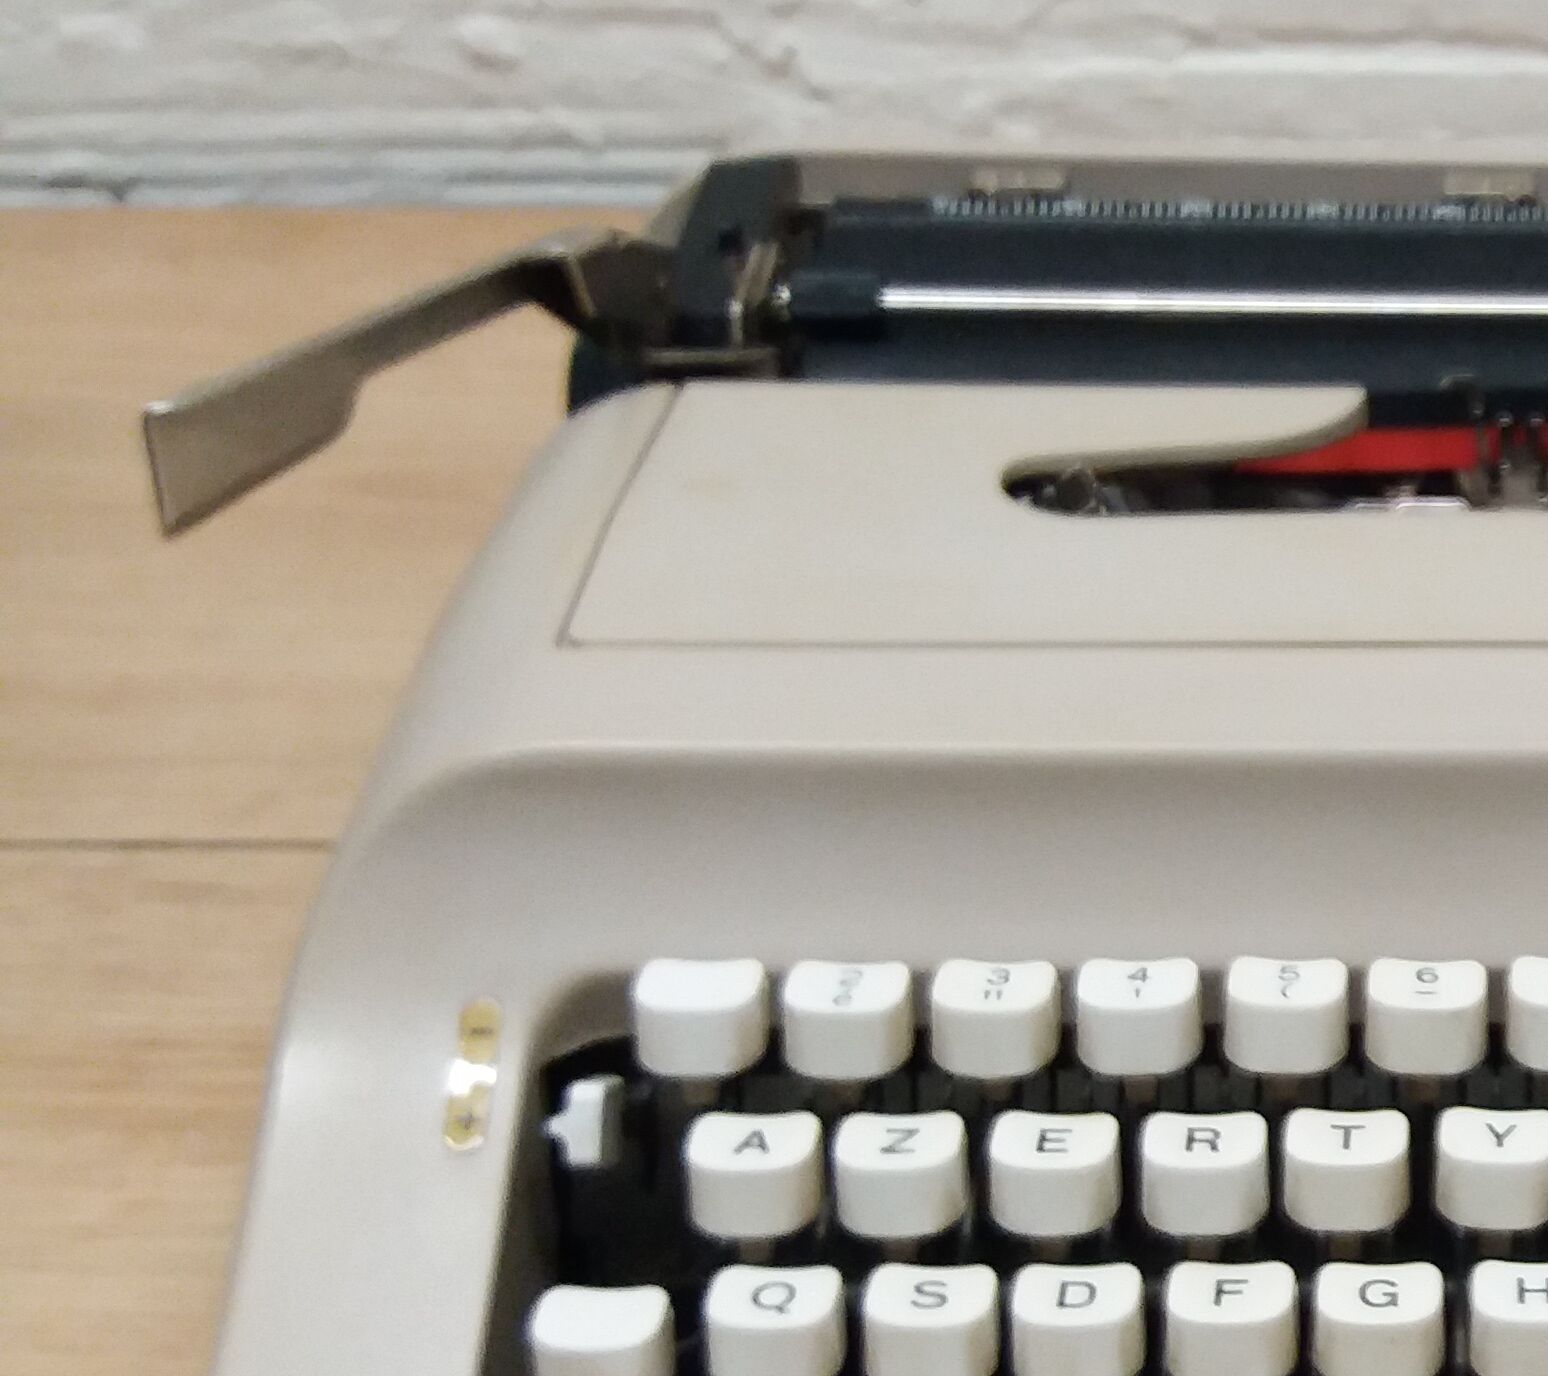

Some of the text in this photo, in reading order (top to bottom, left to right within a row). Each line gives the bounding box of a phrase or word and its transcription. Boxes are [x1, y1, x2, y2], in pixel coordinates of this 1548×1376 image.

[985, 968, 1011, 986] 3
[1126, 967, 1149, 984] 4
[1277, 965, 1300, 982] 5
[1415, 966, 1440, 984] 6
[733, 1130, 770, 1154] A
[879, 1128, 920, 1155] Z
[1035, 1128, 1072, 1154] E
[1184, 1127, 1222, 1152] R
[1330, 1124, 1366, 1151] T
[1484, 1122, 1518, 1149] Y
[751, 1280, 797, 1314] Q
[910, 1281, 950, 1310] S
[1055, 1280, 1098, 1310] D
[1211, 1278, 1250, 1308] F
[1358, 1278, 1400, 1309] G
